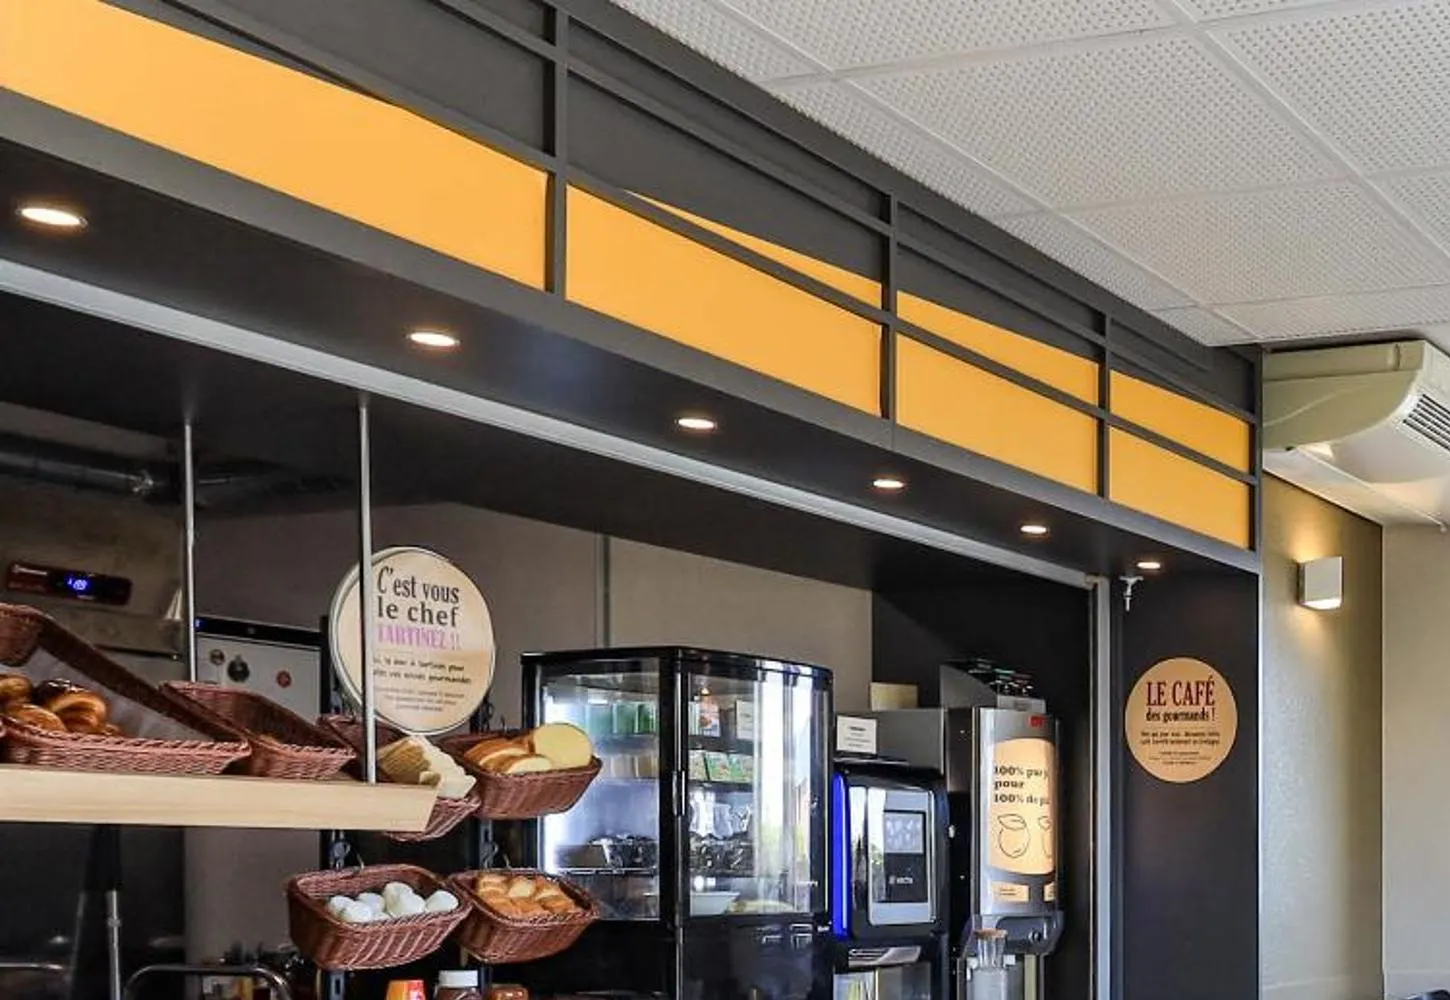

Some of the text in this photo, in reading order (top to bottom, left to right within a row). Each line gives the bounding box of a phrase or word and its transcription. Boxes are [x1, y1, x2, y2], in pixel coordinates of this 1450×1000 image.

[377, 566, 460, 604] C'est vous
[377, 595, 460, 627] le chef
[1146, 675, 1215, 706] LE CAFÉ
[994, 765, 1024, 776] 100%
[994, 780, 1025, 790] pour
[994, 793, 1024, 803] 100%
